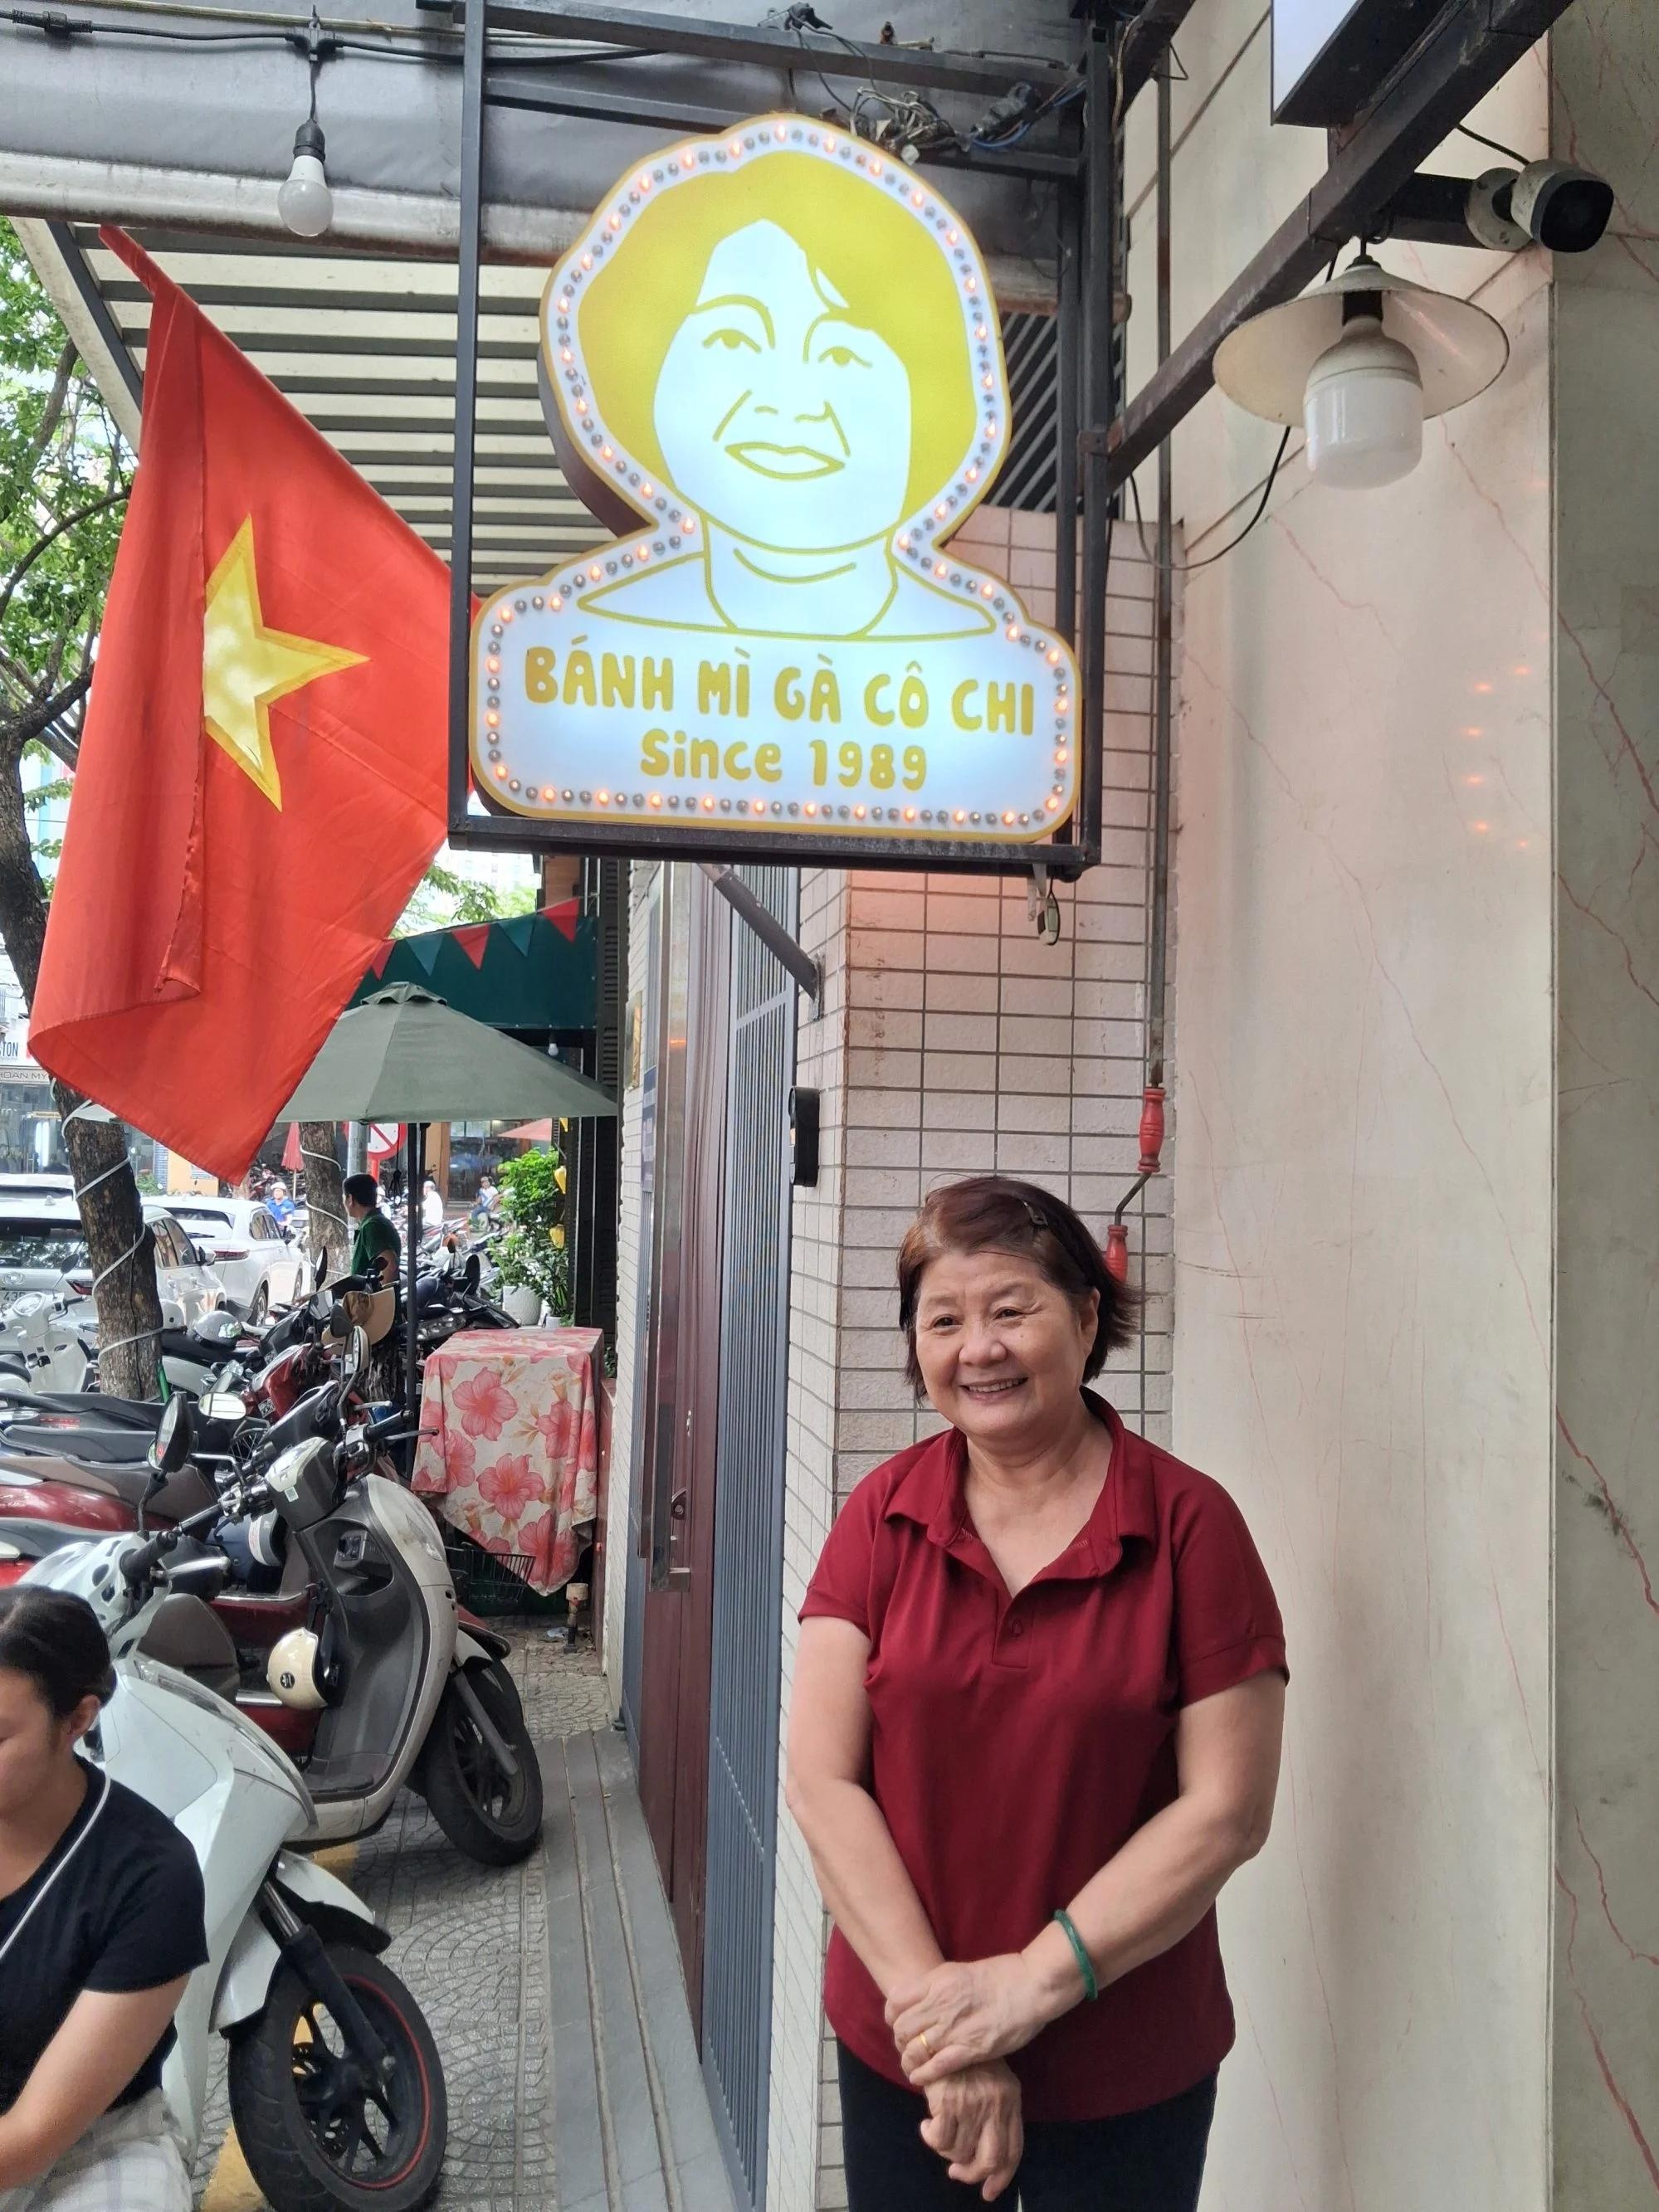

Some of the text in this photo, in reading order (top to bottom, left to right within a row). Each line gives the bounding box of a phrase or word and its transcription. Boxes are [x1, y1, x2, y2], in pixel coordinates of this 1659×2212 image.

[525, 634, 1034, 735] BÁNH MÌ GÀ CÔ CHI
[641, 729, 927, 792] Since 1989
[0, 1041, 18, 1057] TON
